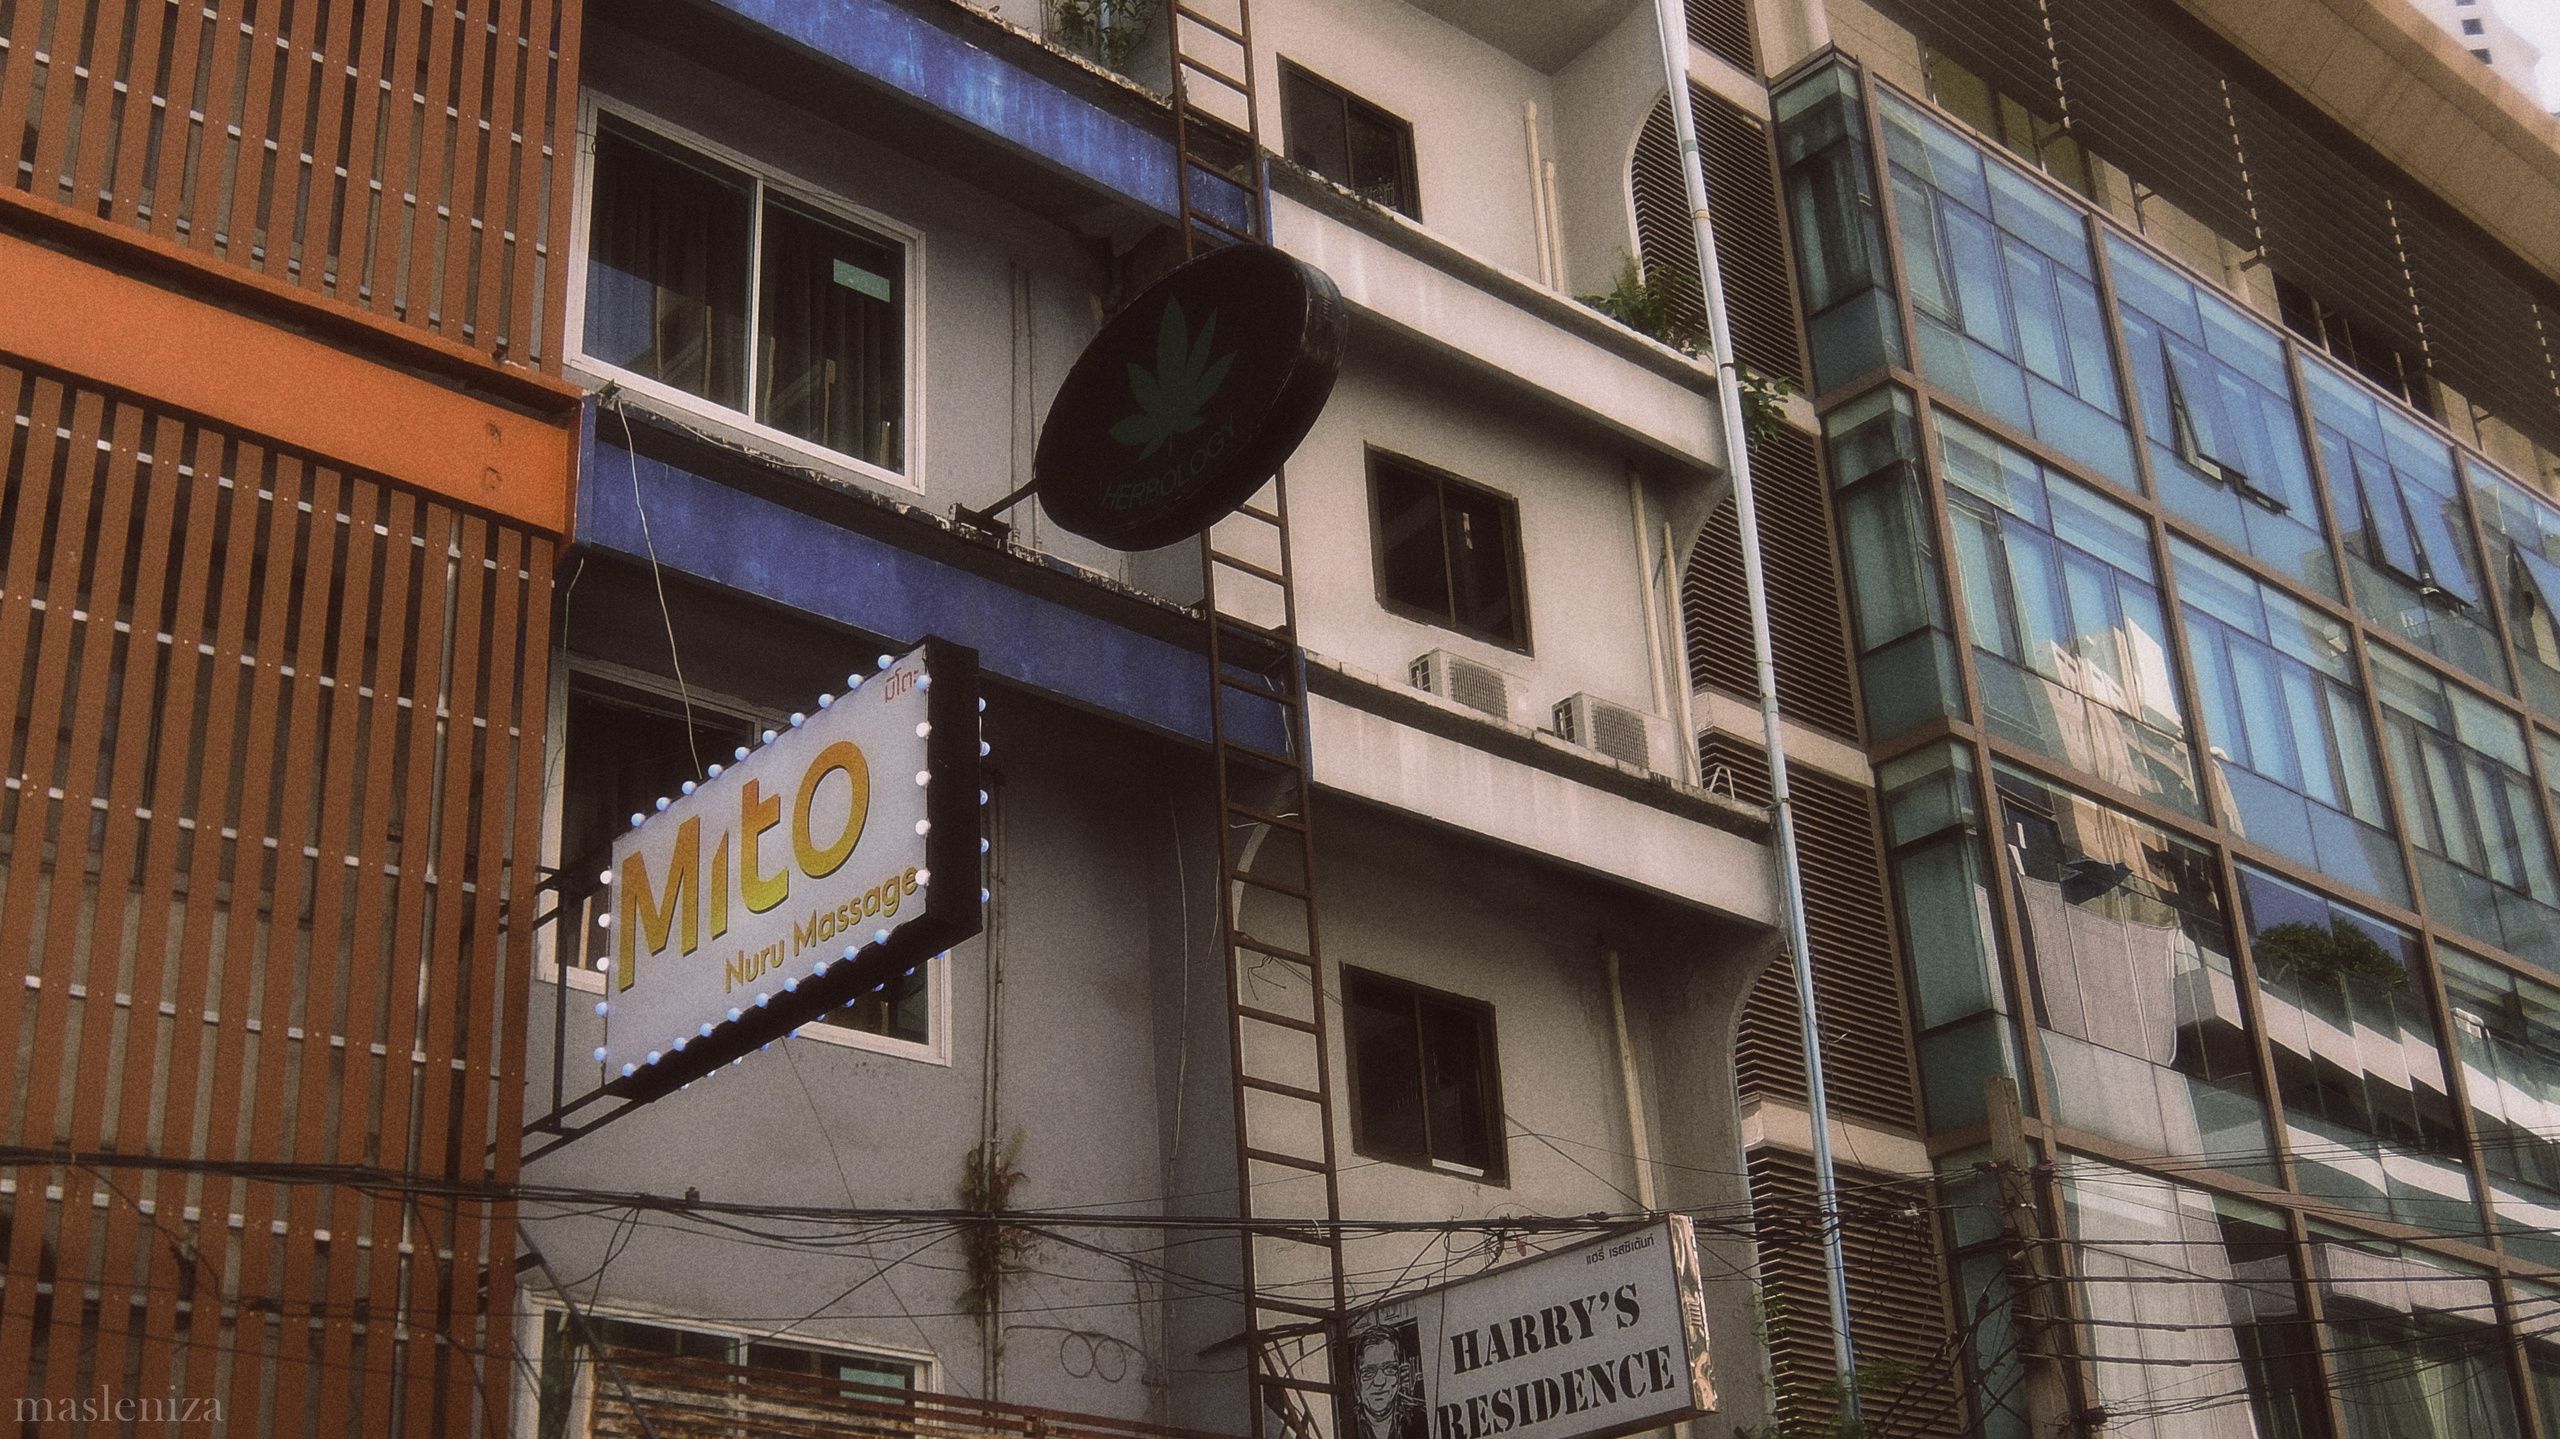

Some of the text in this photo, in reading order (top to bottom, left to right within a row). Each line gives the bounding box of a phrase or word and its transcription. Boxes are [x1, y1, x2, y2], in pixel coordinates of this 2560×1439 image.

[725, 865, 918, 993] Nuru Massage
[1437, 1345, 1676, 1439] RESIDENCE
